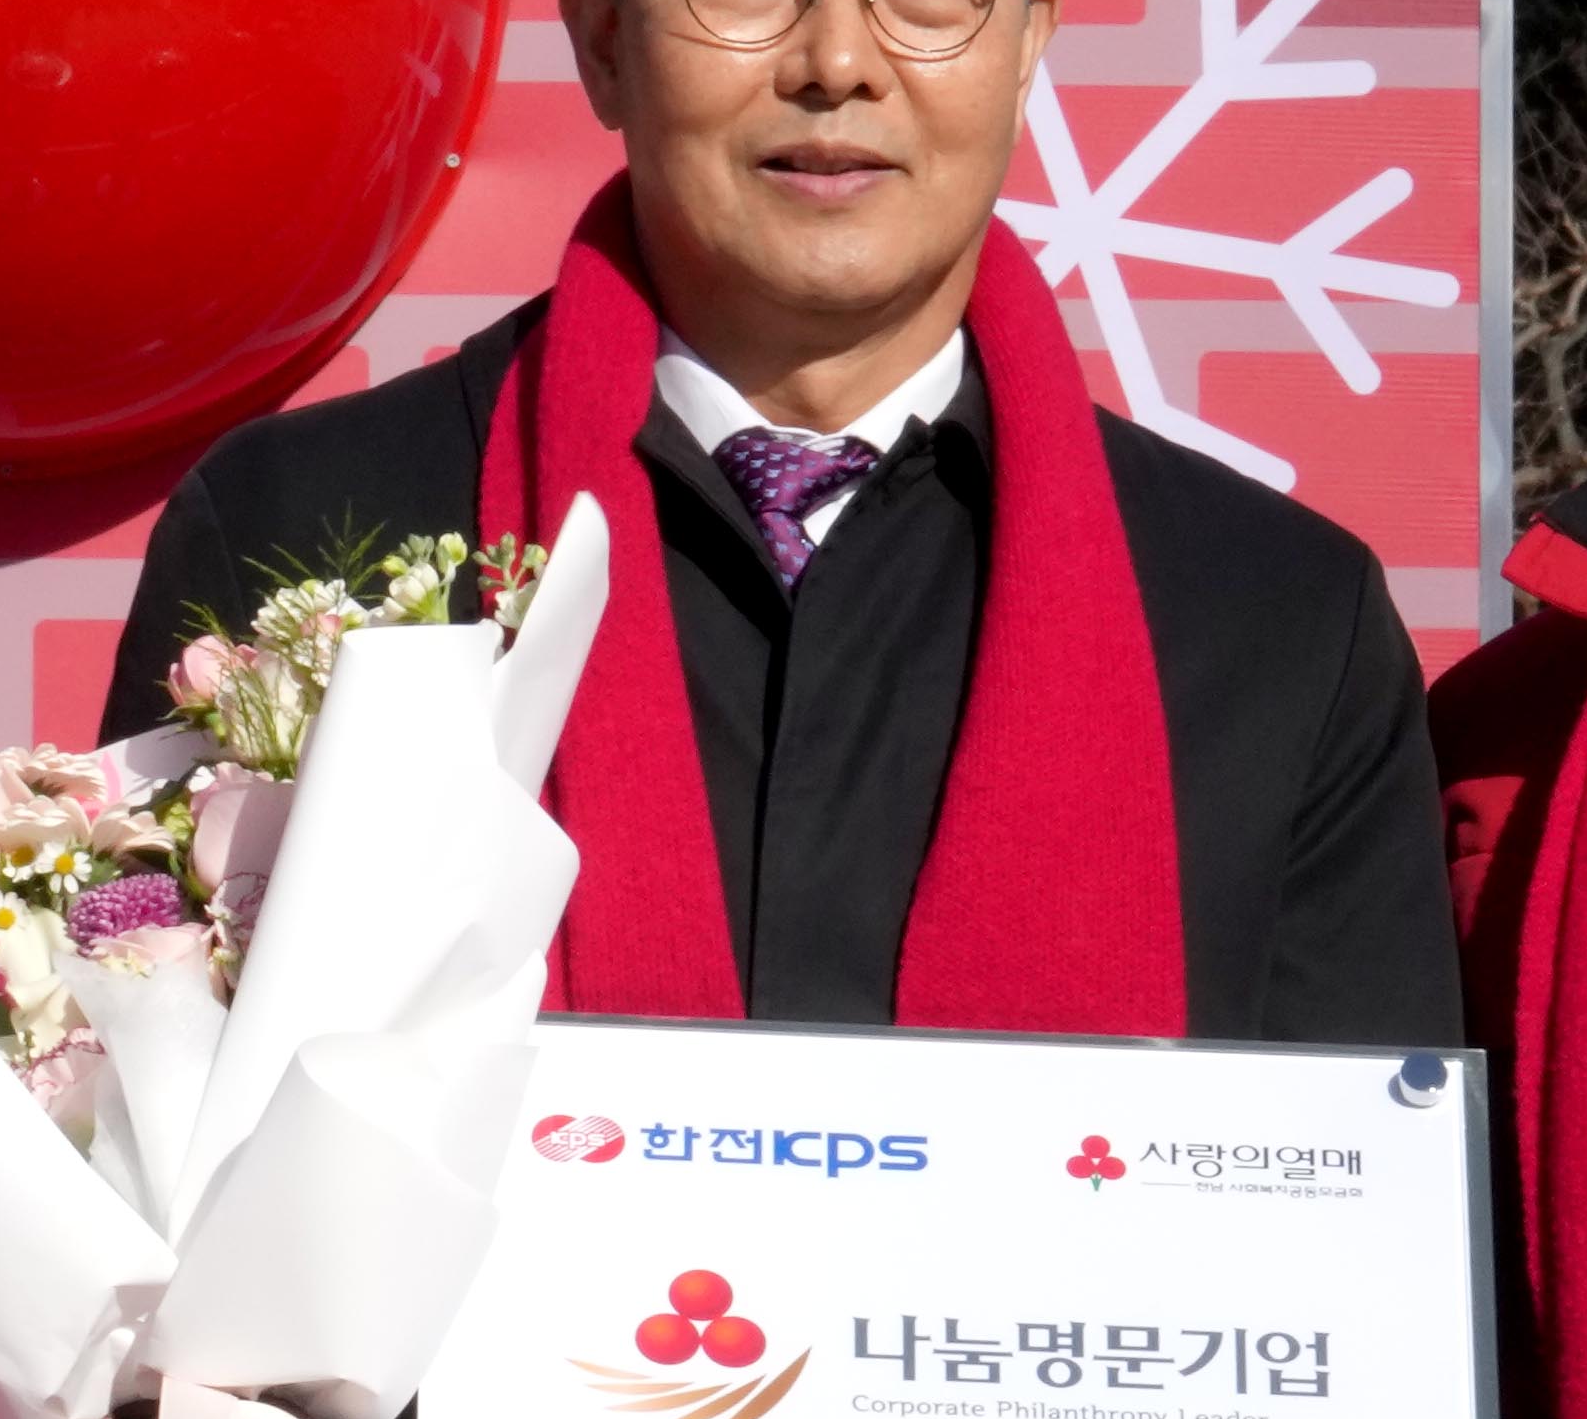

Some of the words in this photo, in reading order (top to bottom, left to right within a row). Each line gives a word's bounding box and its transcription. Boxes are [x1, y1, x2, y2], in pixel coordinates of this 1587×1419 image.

[1141, 1142, 1362, 1180] 사랑의열매
[852, 1315, 1330, 1399] 나눔명문기업
[851, 1394, 986, 1417] Corporate
